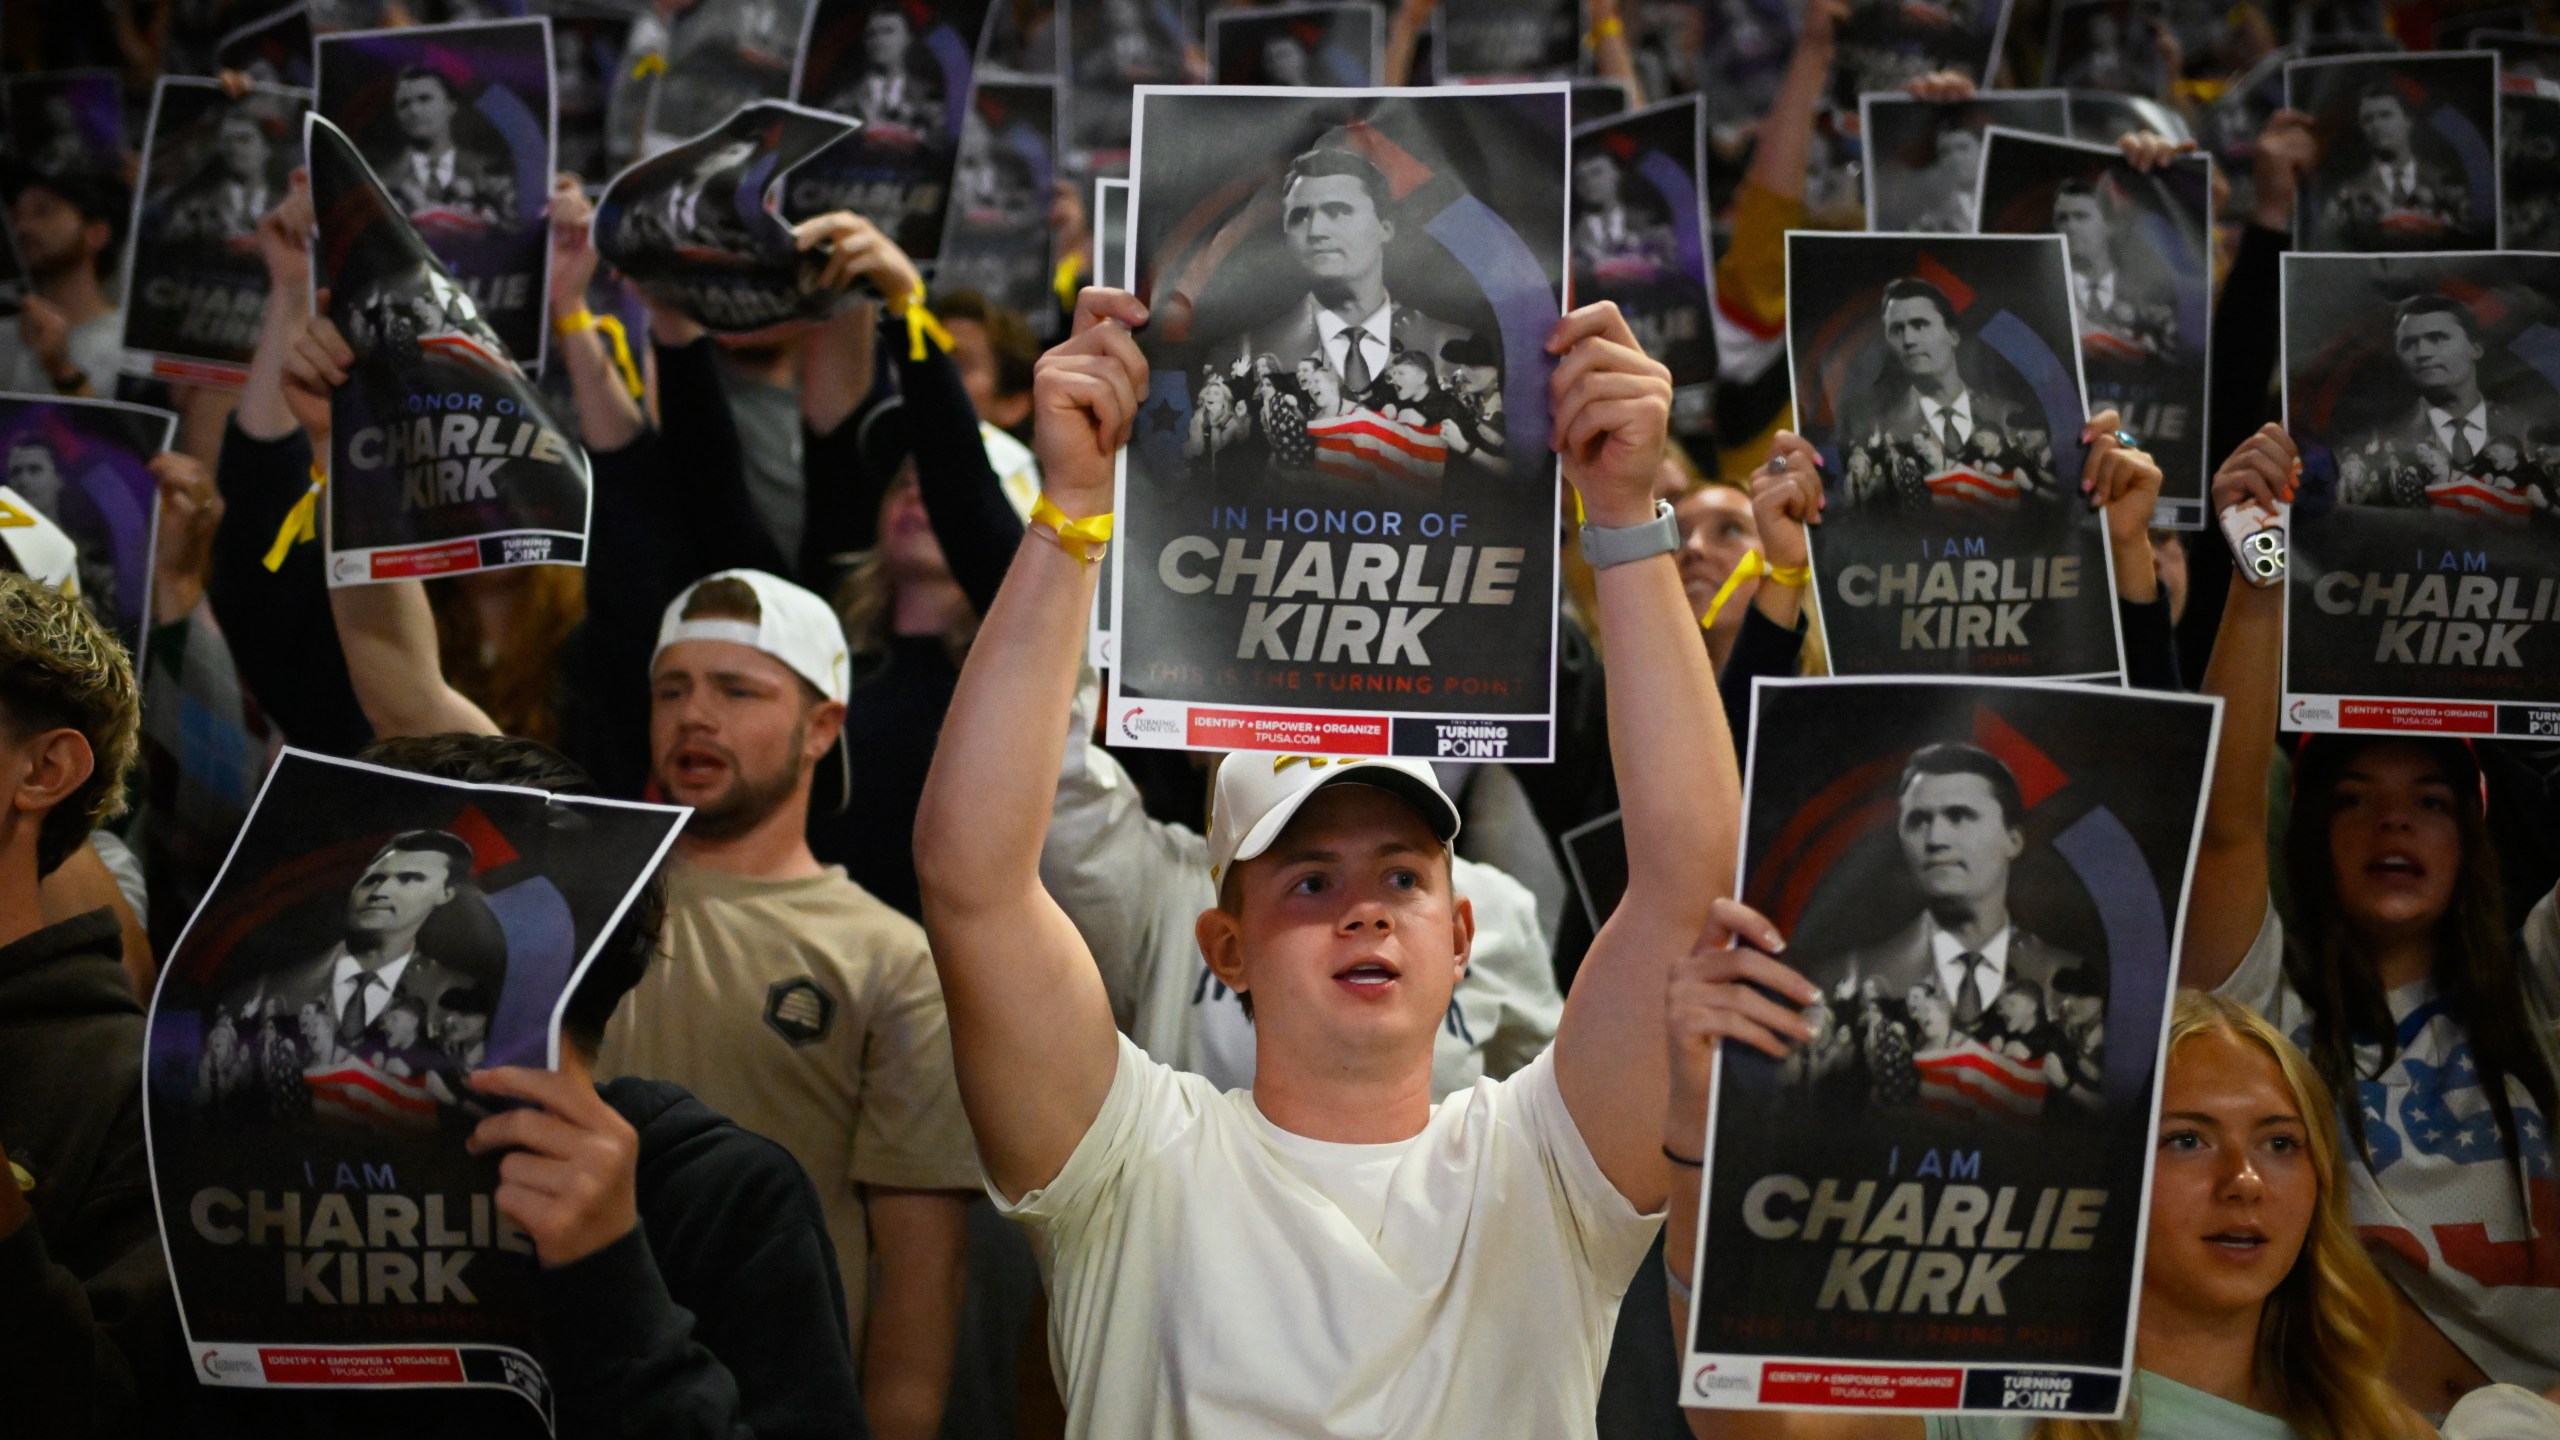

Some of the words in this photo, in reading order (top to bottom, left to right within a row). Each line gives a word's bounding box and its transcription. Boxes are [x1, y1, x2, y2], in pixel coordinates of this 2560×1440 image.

[349, 413, 566, 470] CHARLIE
[401, 456, 509, 513] KIRK
[1211, 506, 1248, 530] IN
[1266, 508, 1402, 536] HONOR
[1419, 512, 1469, 538] OF
[1922, 537, 1929, 559] I
[1943, 536, 1986, 558] AM
[2416, 548, 2423, 570] I
[2438, 550, 2488, 573] AM
[1157, 535, 1526, 606] CHARLIE
[1837, 554, 2082, 608] CHARLIE
[2313, 569, 2560, 623] CHARLI
[1236, 601, 1445, 667] KIRK
[1900, 602, 2032, 650] KIRK
[2373, 618, 2534, 668] KIRK
[1312, 671, 1435, 695] TURNING
[1443, 675, 1526, 698] POINT
[1194, 716, 1246, 729] IDENTIFY
[1255, 719, 1314, 733] EMPOWER
[1322, 722, 1382, 736] ORGANIZE
[2344, 705, 2385, 716] IDENTIFY
[2392, 707, 2437, 718] EMPOWER
[2443, 709, 2489, 720] ORGANIZE
[1255, 731, 1321, 745] TPUSA.COM
[1435, 725, 1509, 740] TURNING
[1437, 739, 1509, 758] POINT
[303, 1160, 315, 1189] I
[334, 1161, 397, 1190] AM
[1888, 1145, 1899, 1176] I
[1916, 1148, 1983, 1181] AM
[1741, 1173, 2110, 1251] CHARLIE
[284, 1250, 480, 1305] KIRK
[1814, 1246, 2026, 1317] KIRK
[268, 1355, 317, 1366] IDENTIFY
[326, 1356, 384, 1367] EMPOWER
[393, 1355, 451, 1367] ORGANIZE
[330, 1366, 395, 1377] TPUSA.COM
[2003, 1375, 2073, 1391] TURNING
[2001, 1389, 2073, 1410] POINT
